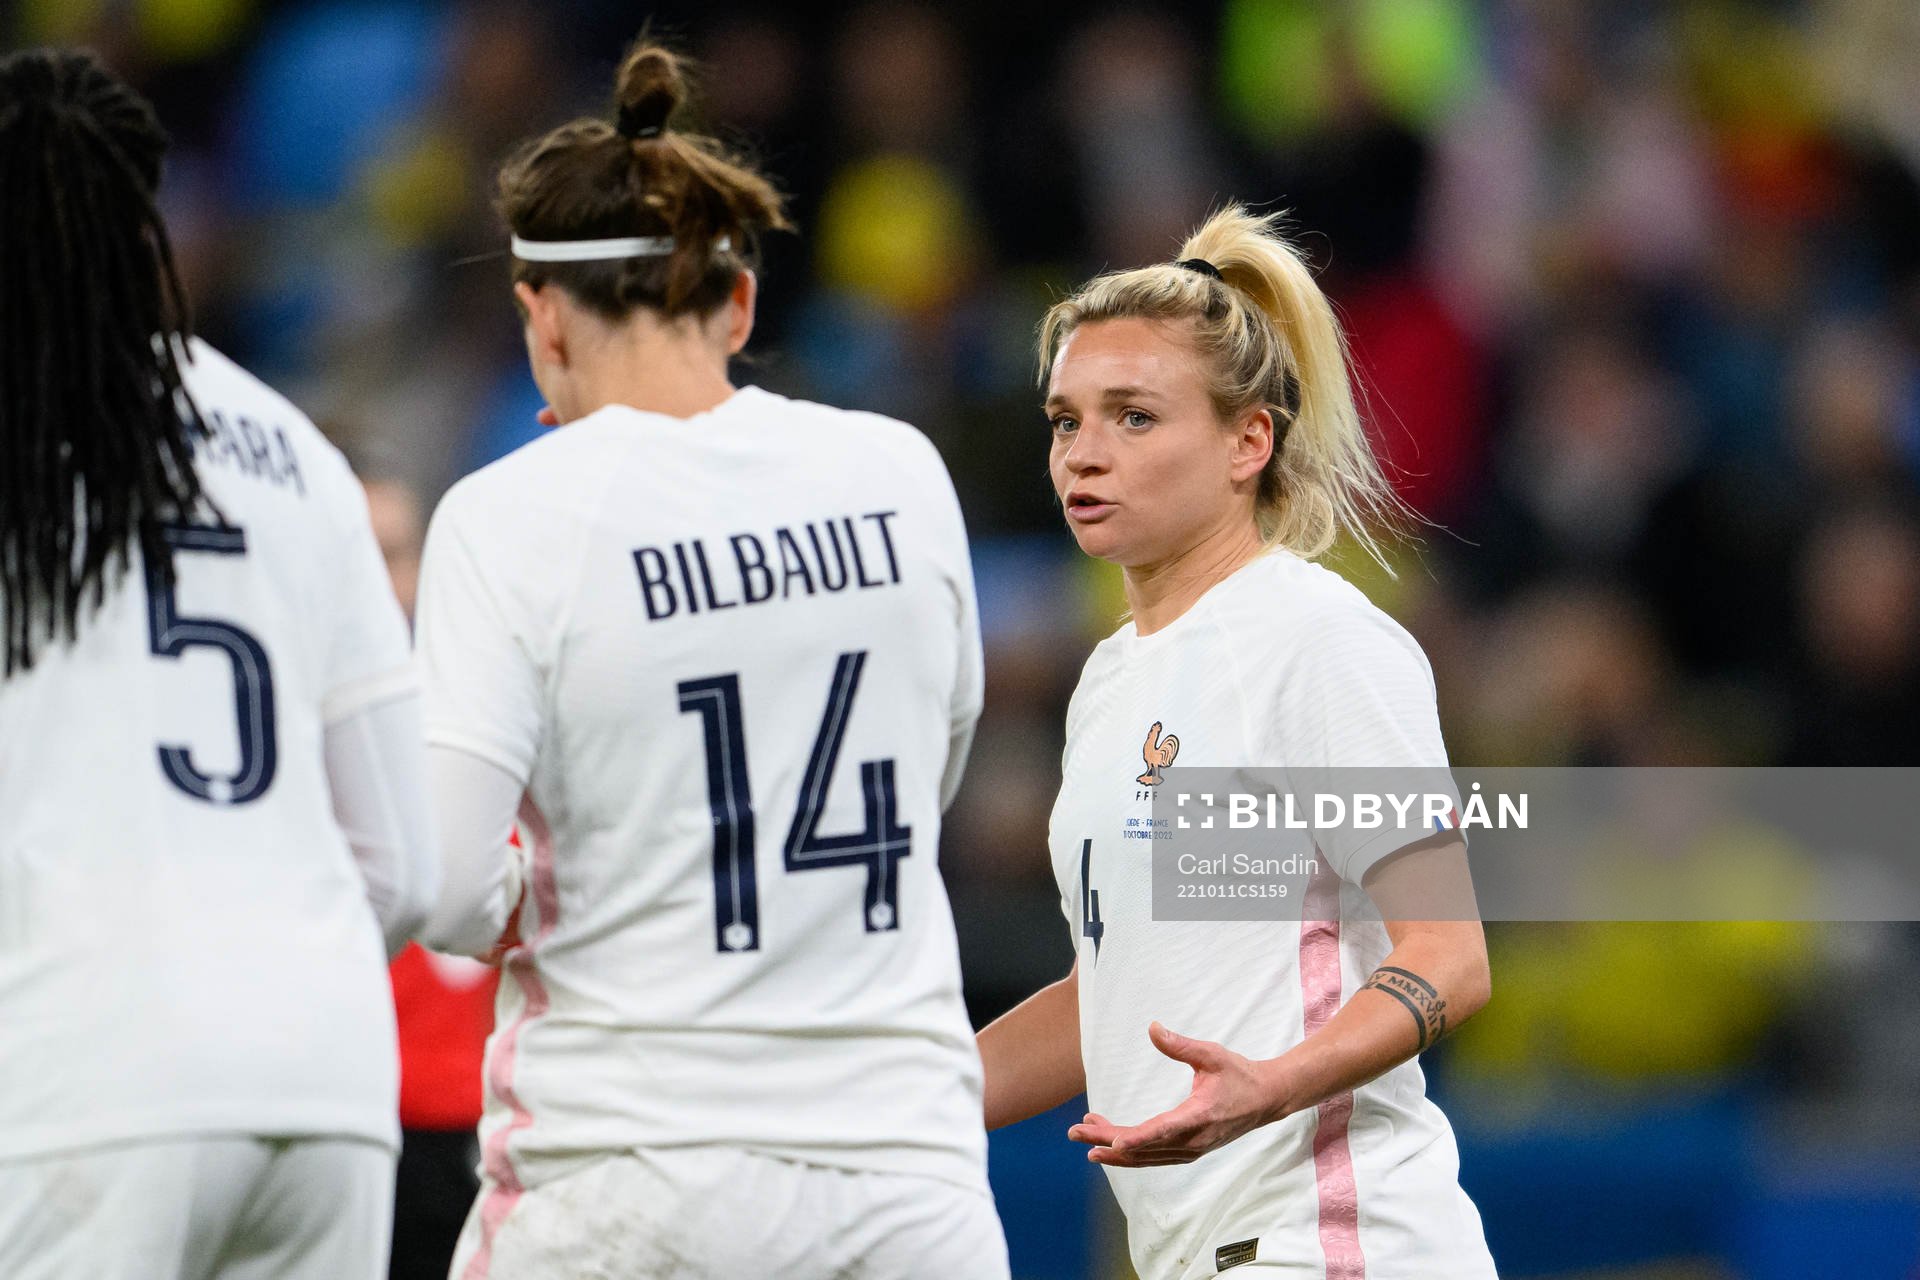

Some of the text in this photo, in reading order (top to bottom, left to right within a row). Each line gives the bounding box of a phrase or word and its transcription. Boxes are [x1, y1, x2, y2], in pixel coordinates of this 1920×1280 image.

[632, 511, 903, 622] BILBAULT
[143, 524, 277, 806] 5
[676, 650, 912, 952] 14
[1154, 831, 1173, 840] 2022
